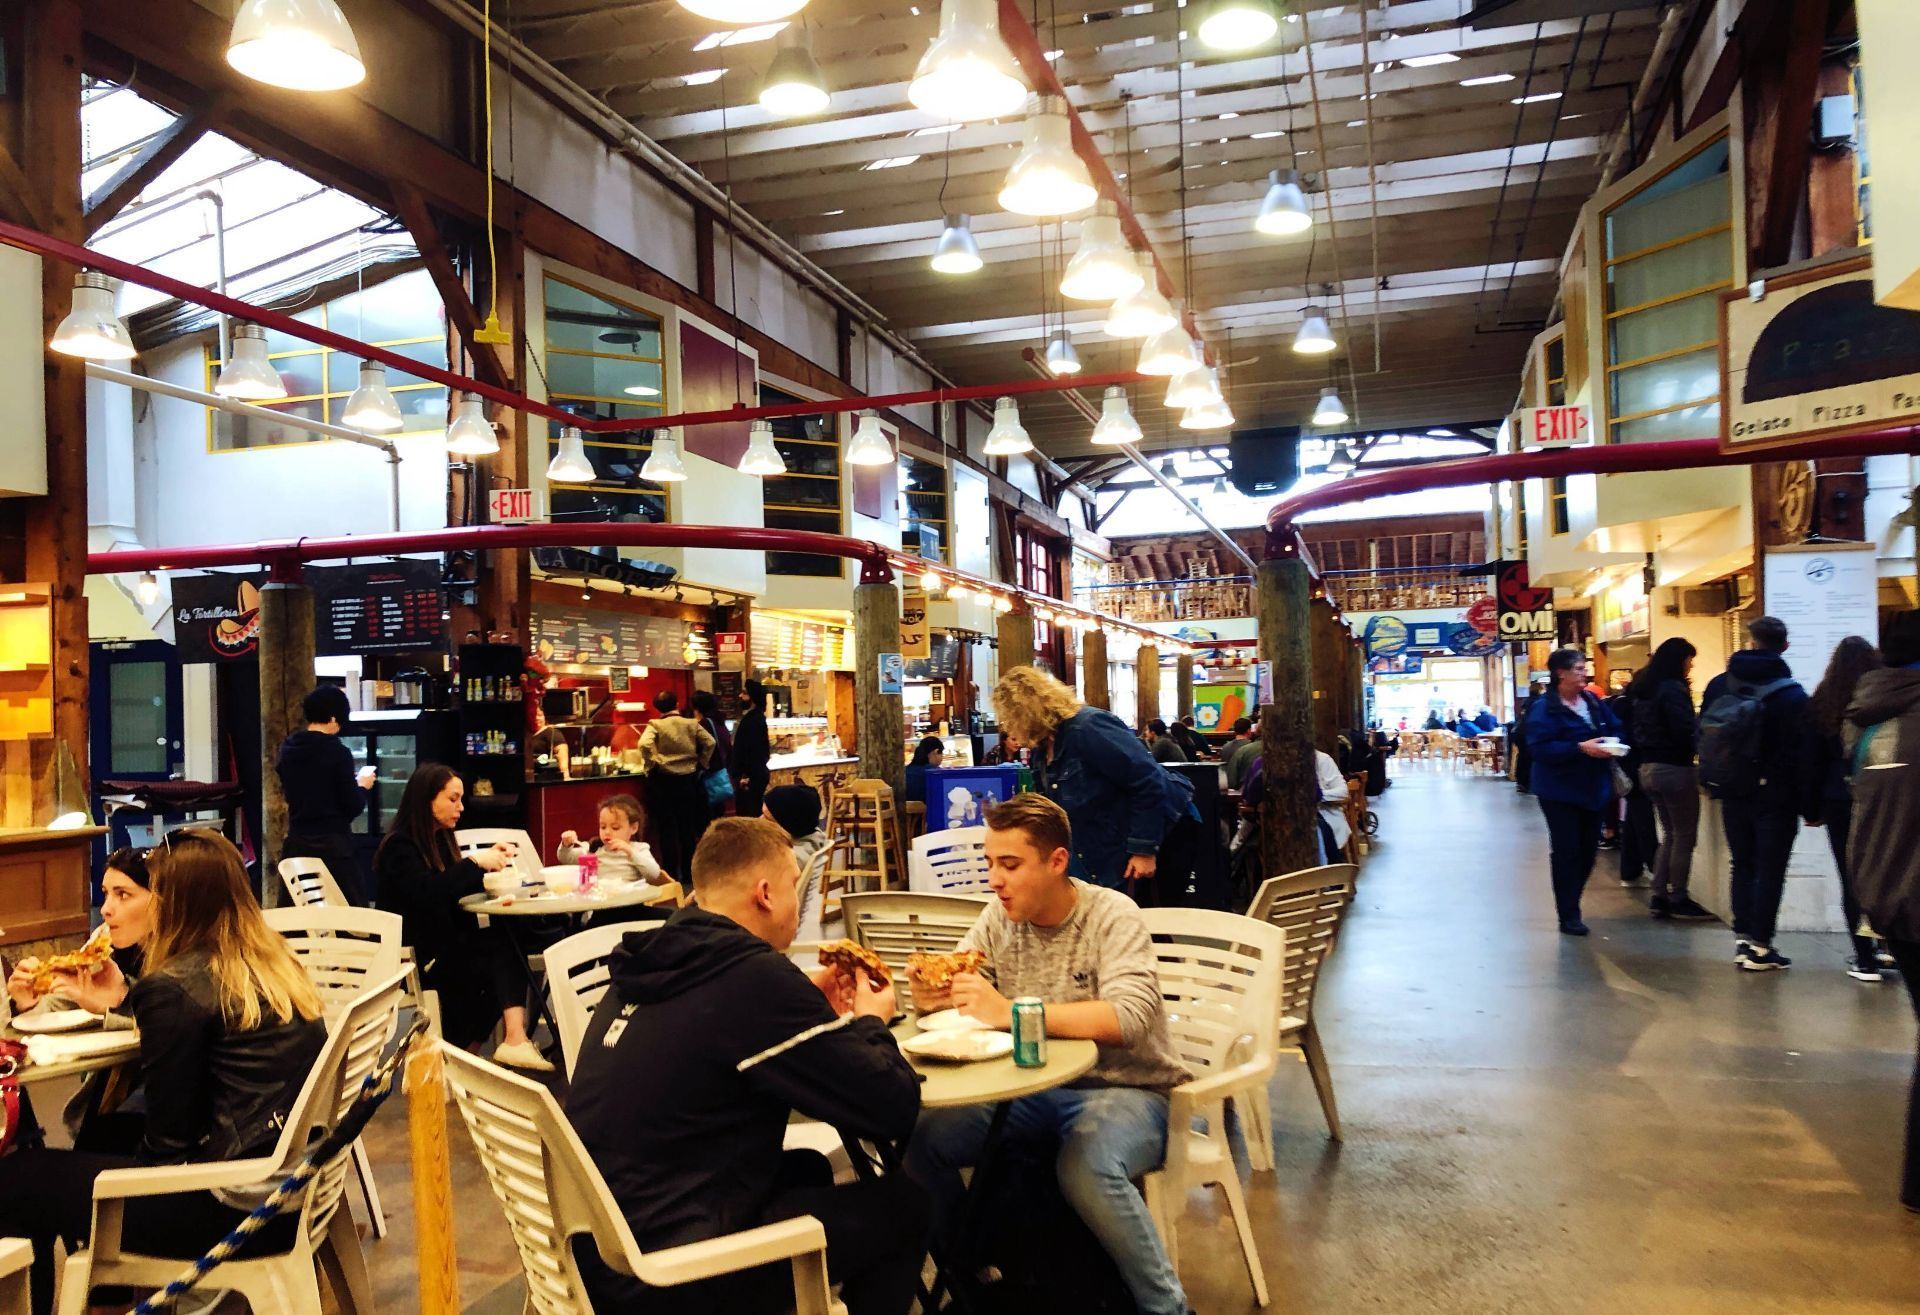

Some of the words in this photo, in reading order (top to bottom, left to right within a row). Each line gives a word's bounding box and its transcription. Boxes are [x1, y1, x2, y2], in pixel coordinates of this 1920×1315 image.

[1535, 407, 1580, 442] EXIT
[1732, 416, 1793, 437] Gelato
[1812, 403, 1867, 423] Pizza
[500, 491, 532, 518] EXIT
[177, 608, 191, 624] La
